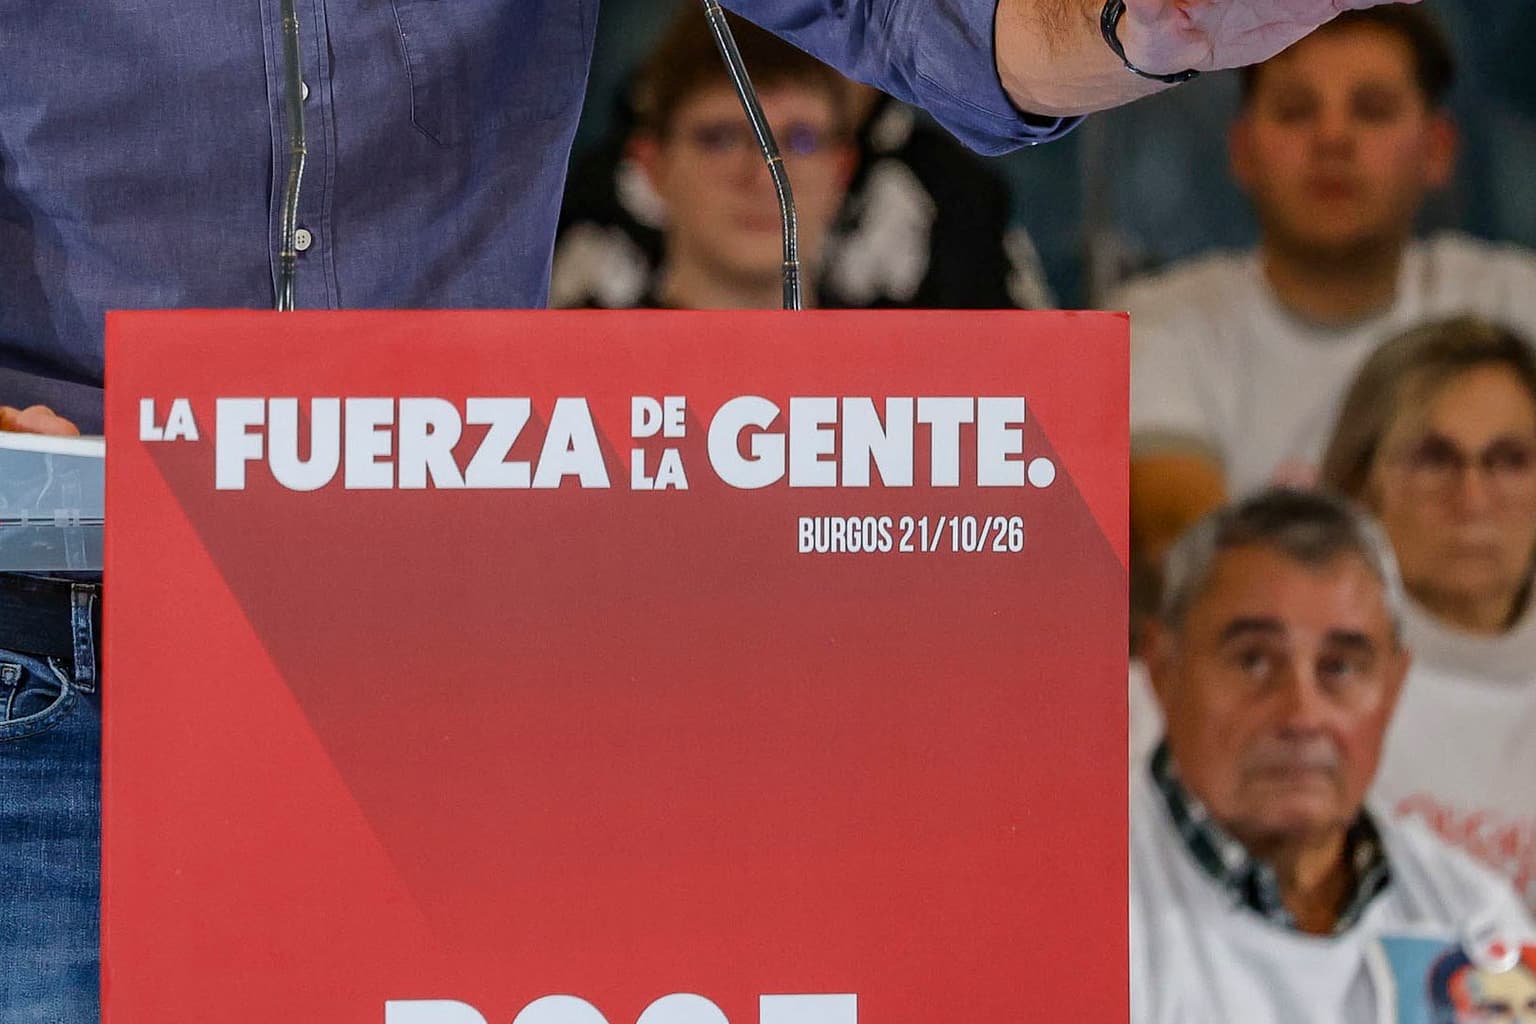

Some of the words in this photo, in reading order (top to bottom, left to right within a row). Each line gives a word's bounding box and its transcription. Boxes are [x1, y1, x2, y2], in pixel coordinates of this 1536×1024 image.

[139, 398, 199, 442] LA
[630, 395, 686, 438] DE
[215, 397, 611, 492] FUERZA
[707, 395, 1056, 490] GENTE.
[630, 448, 689, 490] LA
[798, 516, 893, 553] BURGOS
[899, 515, 1024, 553] 21/10/26
